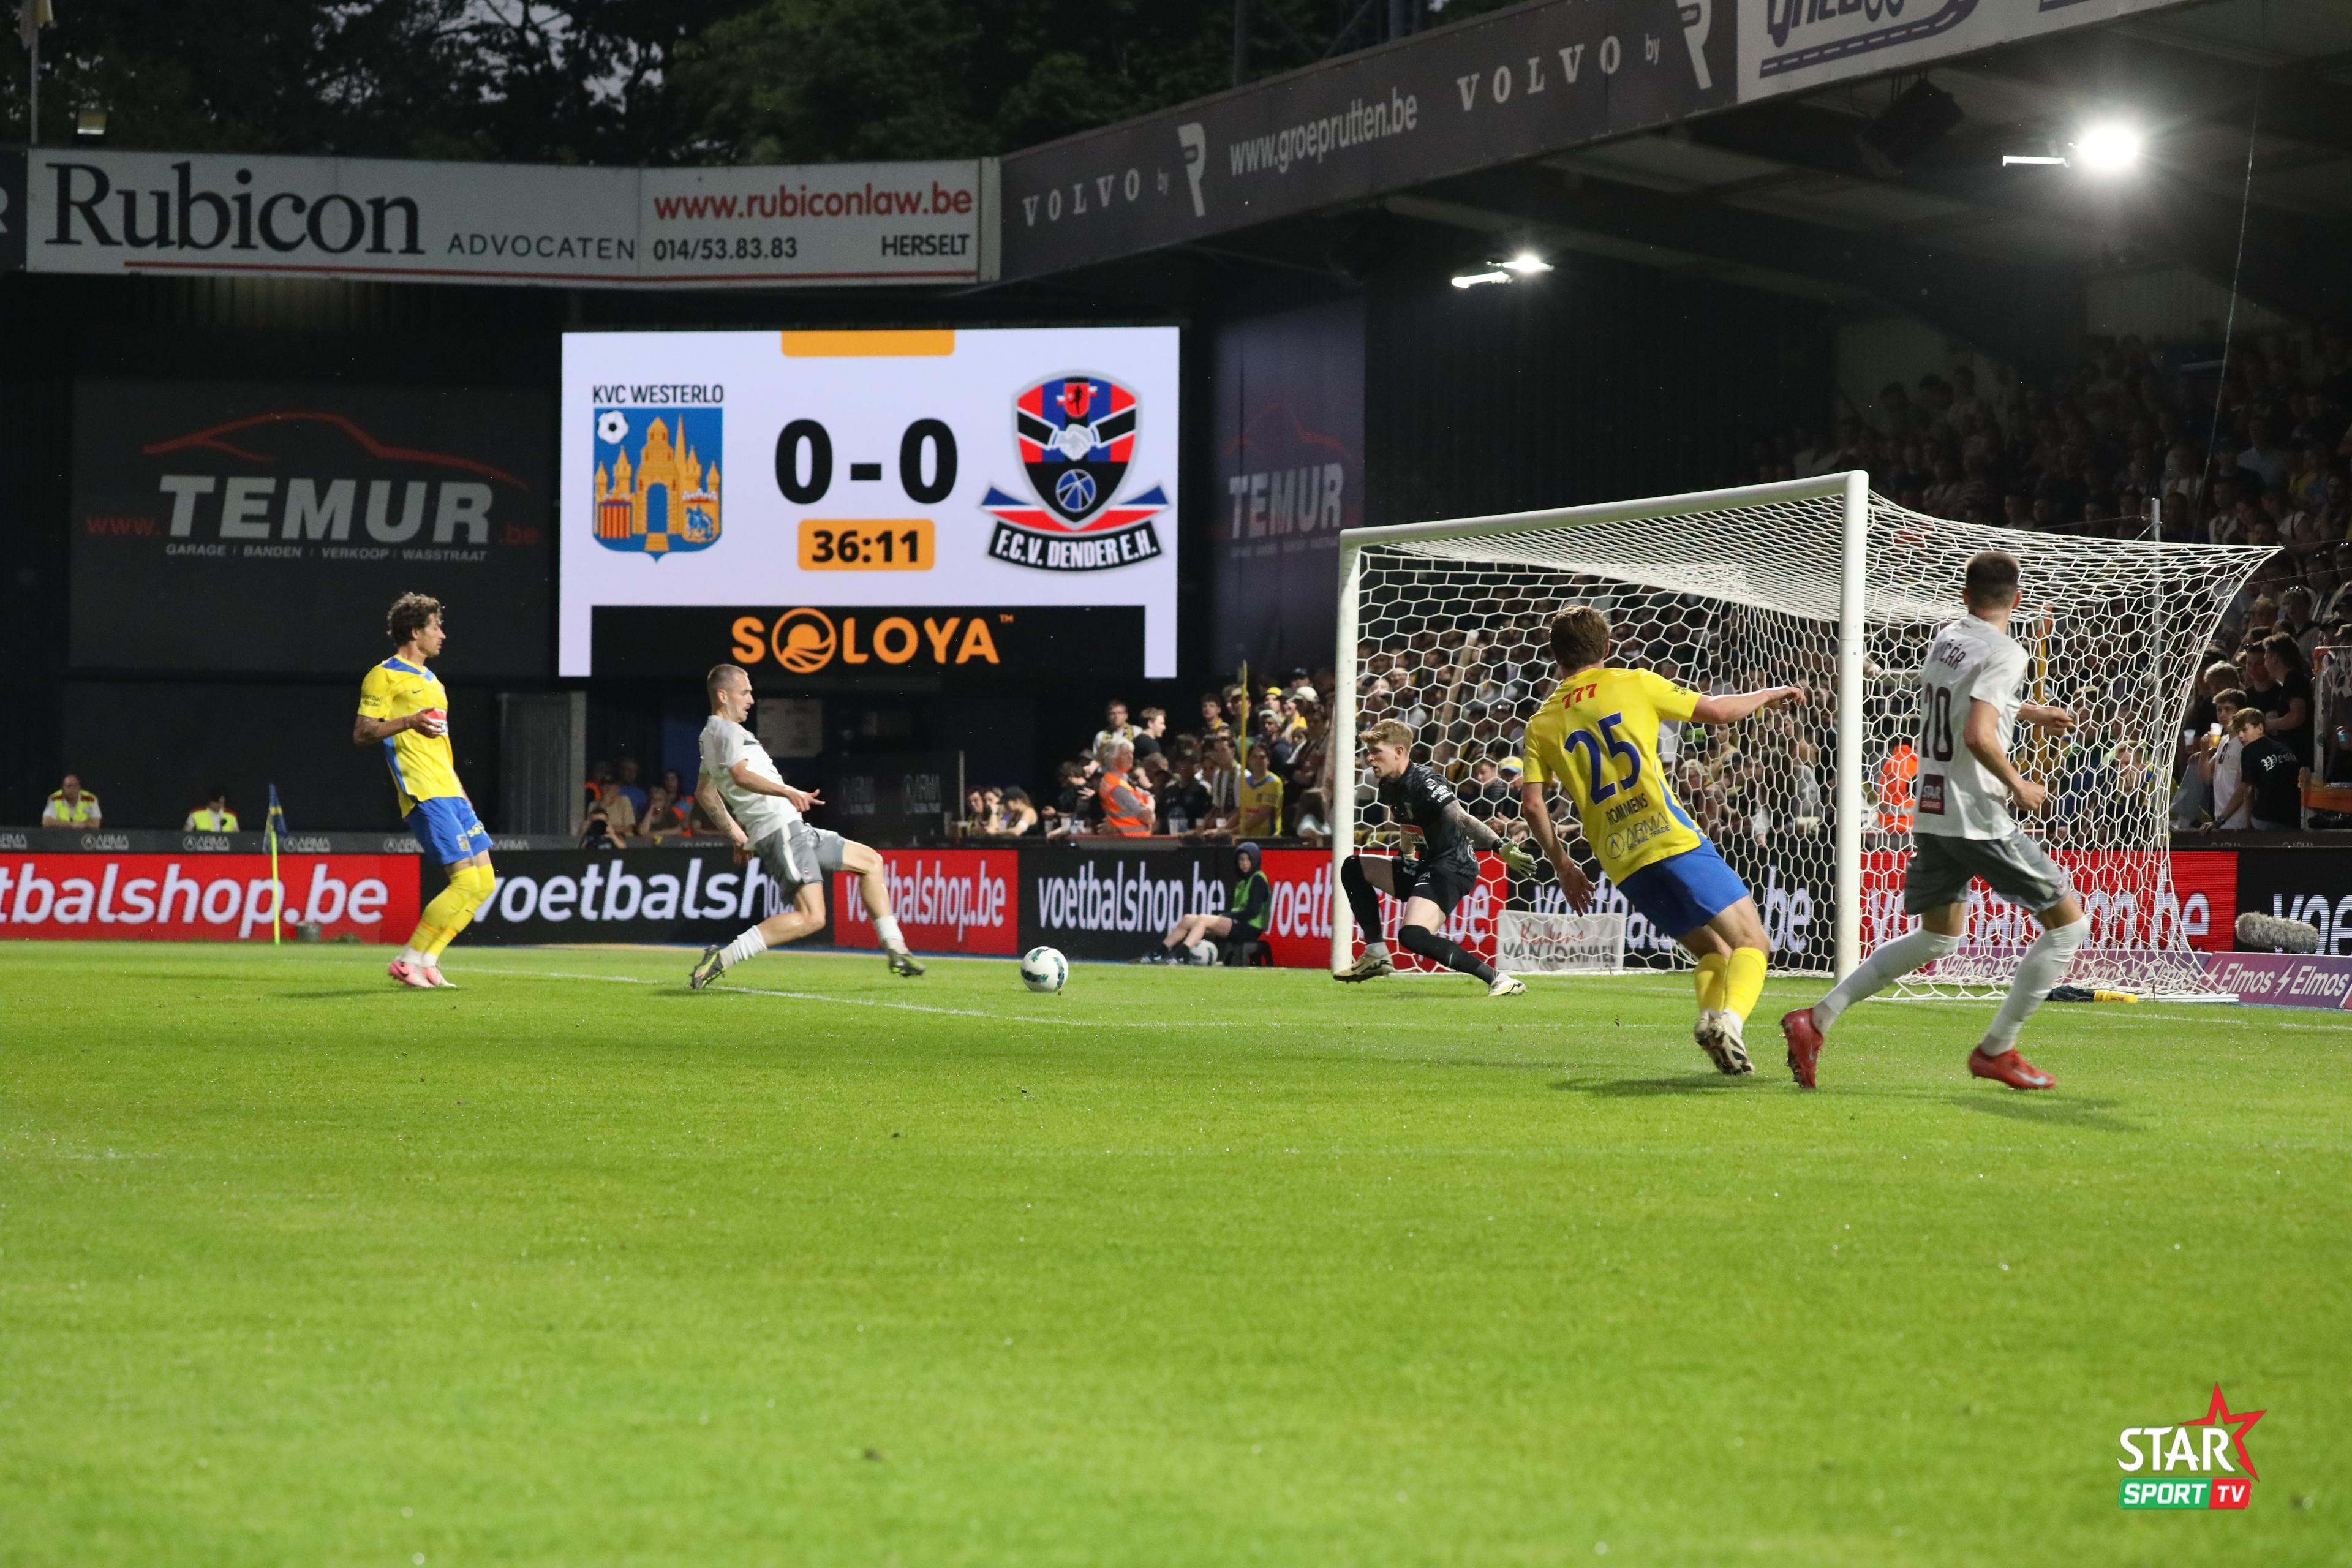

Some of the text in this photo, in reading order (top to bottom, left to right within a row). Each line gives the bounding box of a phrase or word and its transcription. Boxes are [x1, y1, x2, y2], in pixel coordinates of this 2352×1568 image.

[1457, 35, 1621, 111] VOLVO
[1645, 34, 1660, 64] by
[1229, 86, 1418, 176] www.groeprutten.be
[45, 160, 426, 255] Rubicon
[447, 233, 635, 261] ADVOCATEN
[654, 182, 972, 220] www.rubiconlaw.be
[1023, 168, 1140, 227] VOLVO
[653, 233, 970, 261] 014/53.83.83 HERSELT
[593, 384, 724, 404] KVC WESTERLO
[1228, 462, 1344, 539] TEMUR
[166, 543, 488, 562] GARAGE BANDEN VERKOOP WASSTRAAT
[812, 530, 918, 562] 36:11
[995, 528, 1158, 568] F.C.V. DENDER E.H.
[1562, 683, 1598, 710] 777
[1564, 712, 1641, 806] 25
[1605, 793, 1649, 826] ROMMENS
[1503, 943, 1616, 963] VAN LOMMEL
[2218, 963, 2350, 997] Elmos Elmos
